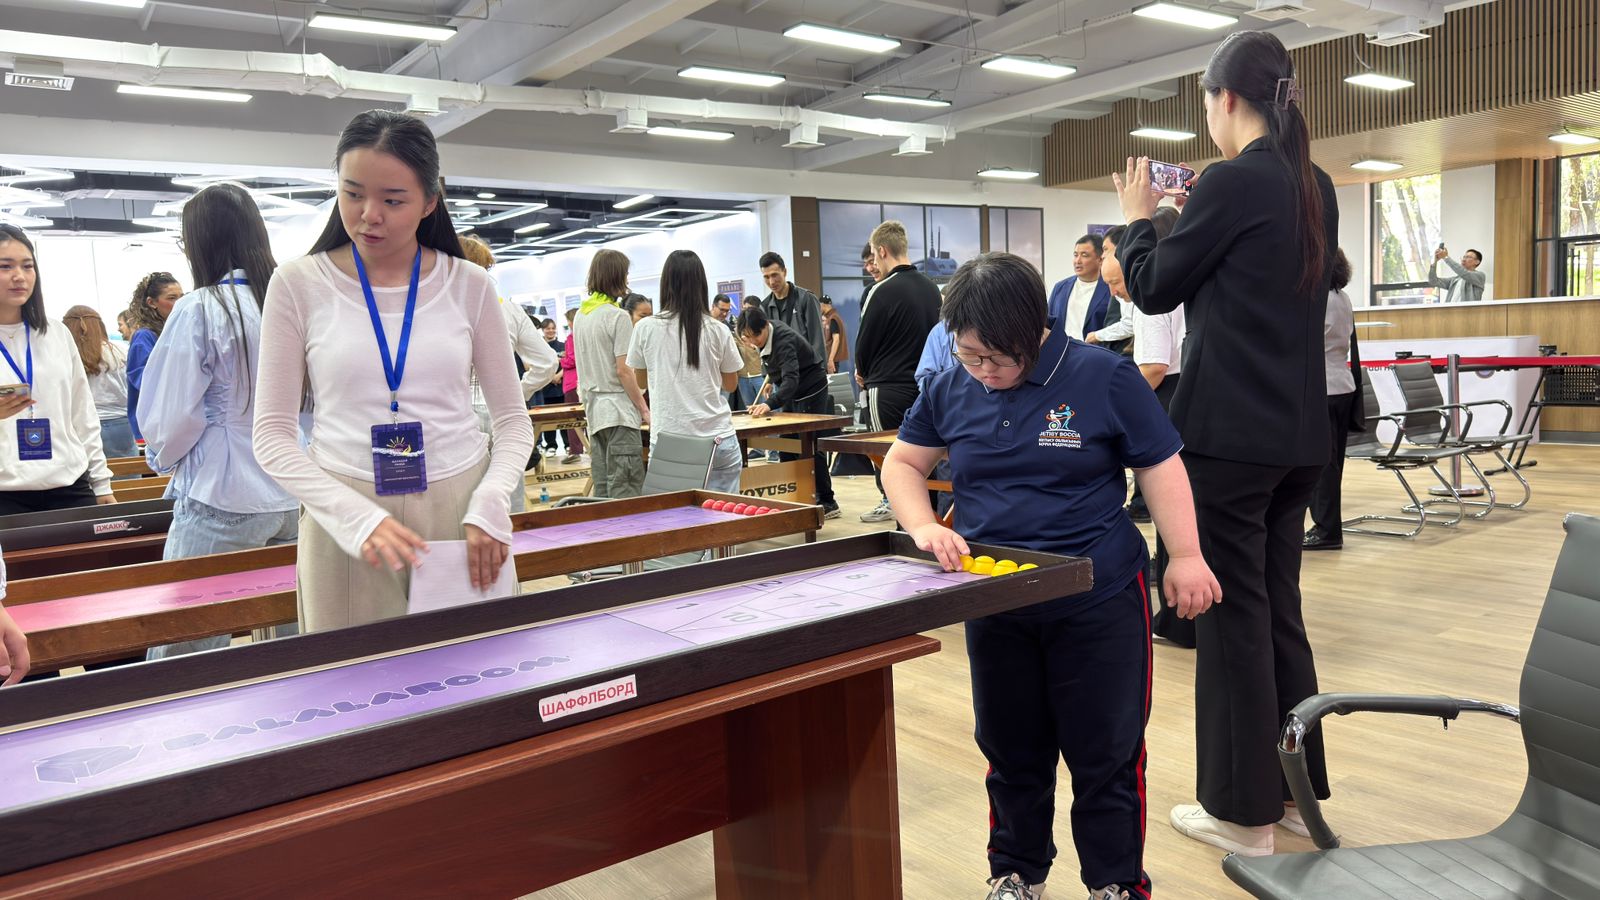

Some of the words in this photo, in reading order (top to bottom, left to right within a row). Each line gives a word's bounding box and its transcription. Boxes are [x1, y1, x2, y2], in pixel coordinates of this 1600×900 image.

[721, 611, 758, 623] 10
[161, 655, 572, 752] BALALAROOM
[541, 681, 636, 718] ШАФФЛБОРД
